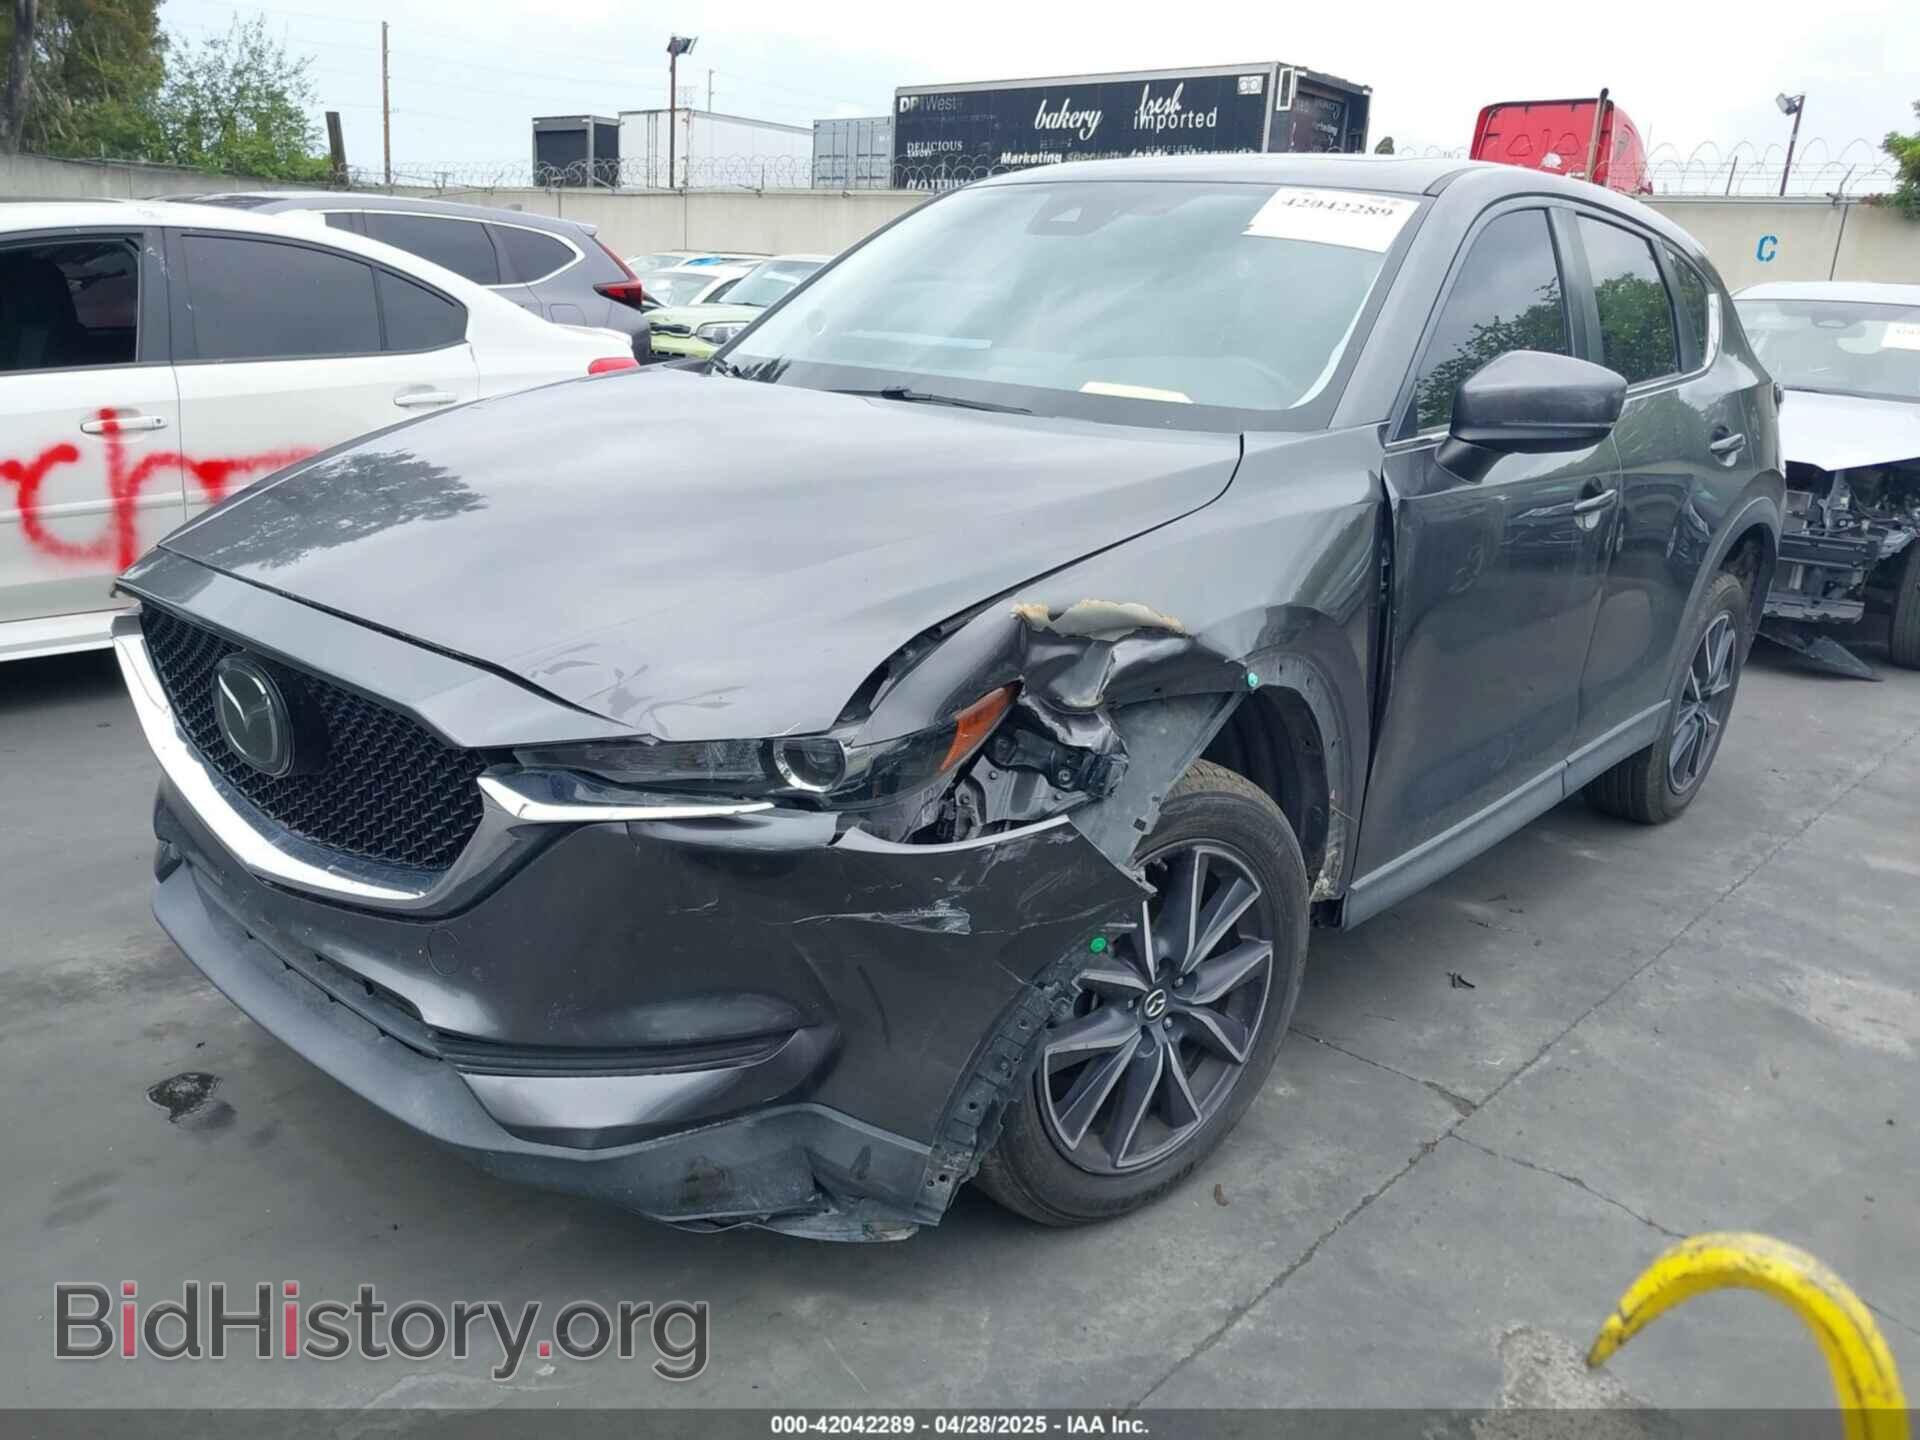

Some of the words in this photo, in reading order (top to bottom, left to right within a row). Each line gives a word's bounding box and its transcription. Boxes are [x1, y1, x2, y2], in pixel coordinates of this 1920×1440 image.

[1139, 81, 1184, 115] fresh
[1034, 98, 1103, 140] bakery
[1133, 106, 1218, 134] imported
[906, 140, 963, 152] DELICIOUS
[1000, 151, 1063, 165] Marketing
[1756, 235, 1778, 262] C
